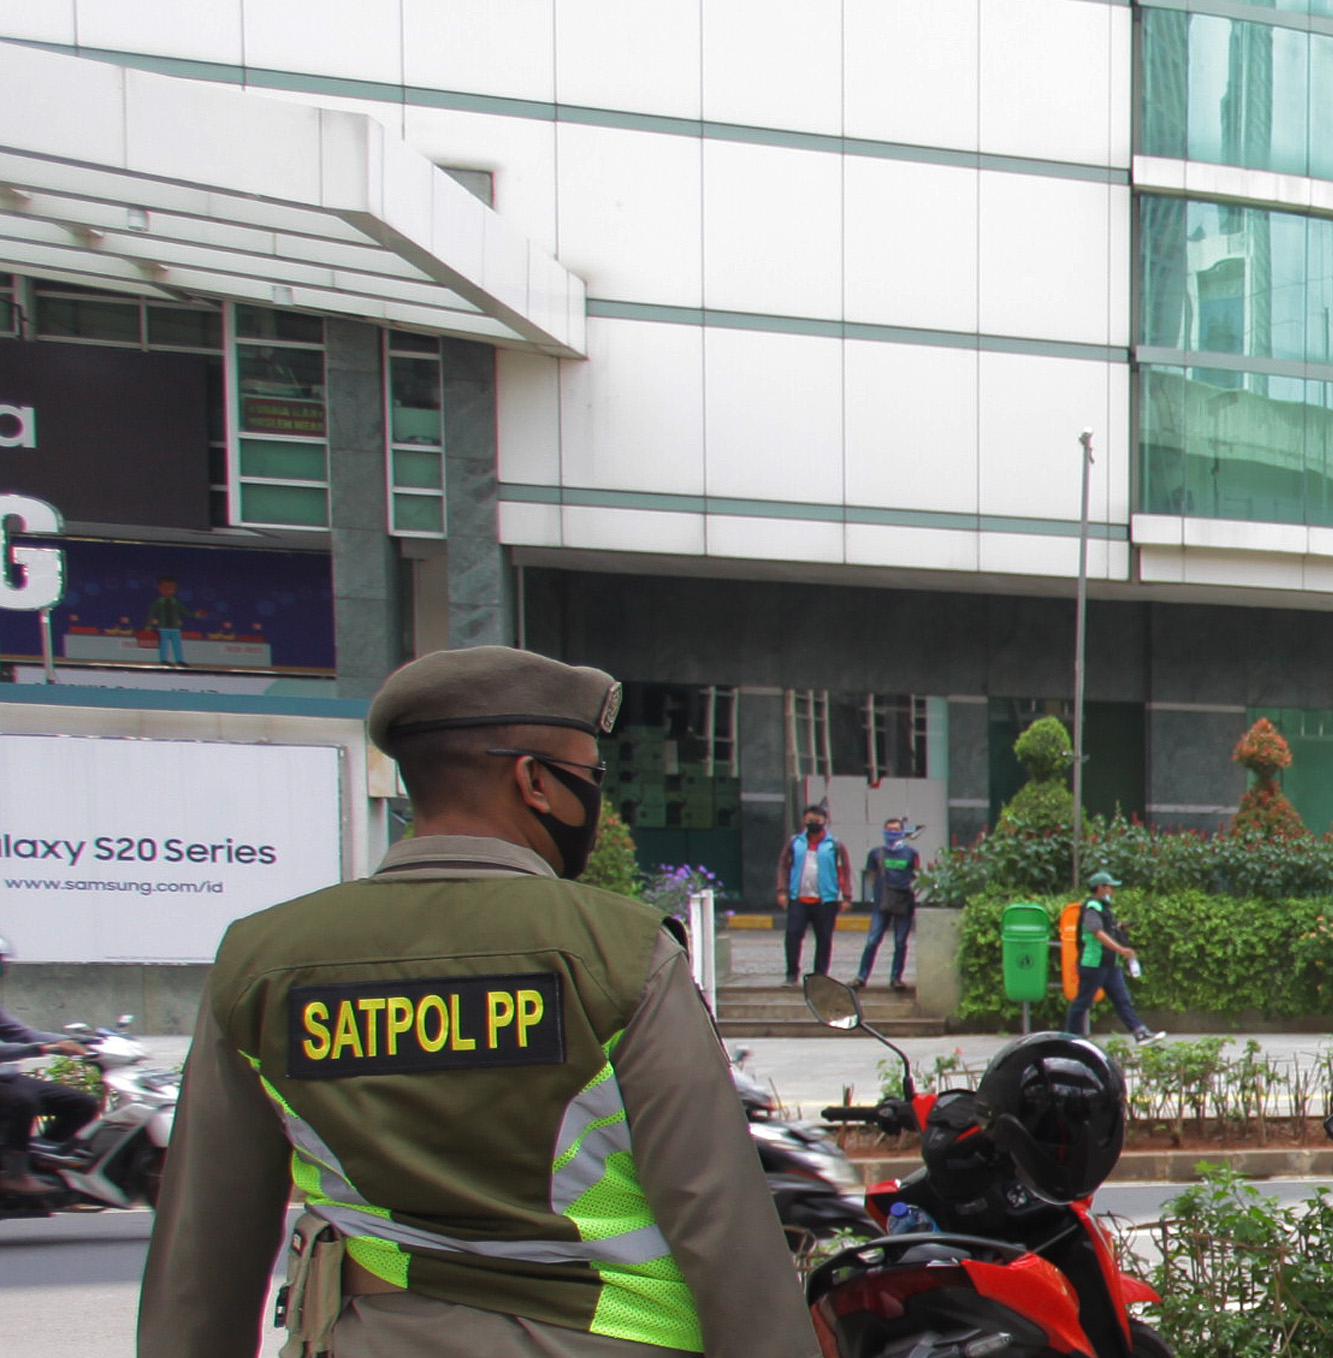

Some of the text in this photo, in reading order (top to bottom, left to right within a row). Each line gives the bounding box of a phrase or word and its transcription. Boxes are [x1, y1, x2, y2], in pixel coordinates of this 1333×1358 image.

[0, 834, 277, 867] laxy S20 Series
[4, 877, 224, 896] www.samsung.com/id
[302, 989, 545, 1060] SATPOL PP
